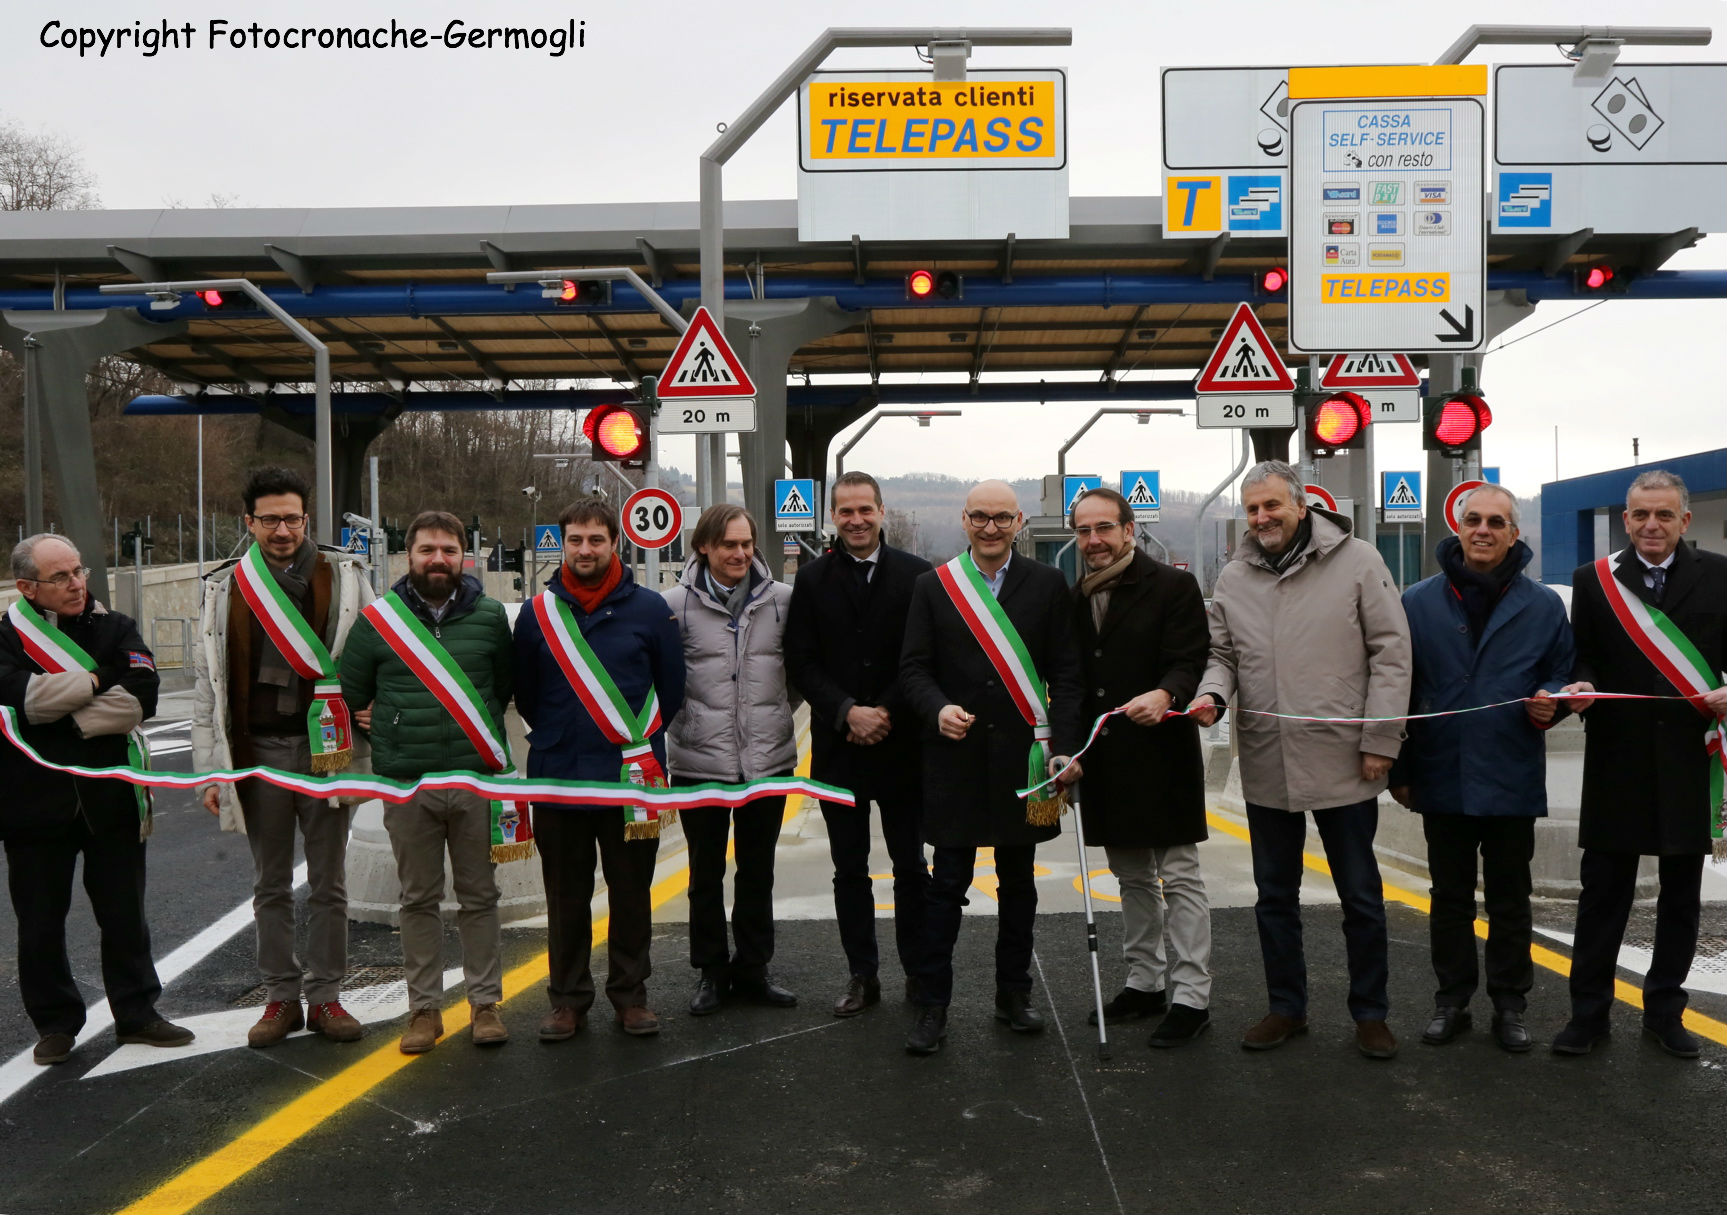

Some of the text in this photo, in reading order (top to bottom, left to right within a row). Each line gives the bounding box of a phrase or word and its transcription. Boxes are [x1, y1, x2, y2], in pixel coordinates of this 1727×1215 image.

[829, 86, 1034, 107] riservata clienti
[1357, 114, 1411, 129] CASSA
[821, 117, 1044, 153] TELEPASS
[1328, 131, 1446, 147] SELF-SERVICE
[1368, 151, 1434, 168] con resto
[1376, 184, 1399, 194] FAST
[1177, 181, 1212, 227] T
[1326, 279, 1447, 298] TELEPASS
[1222, 405, 1269, 418] 20 m
[1381, 402, 1395, 412] m
[683, 410, 730, 423] 20 m
[635, 504, 669, 531] 30
